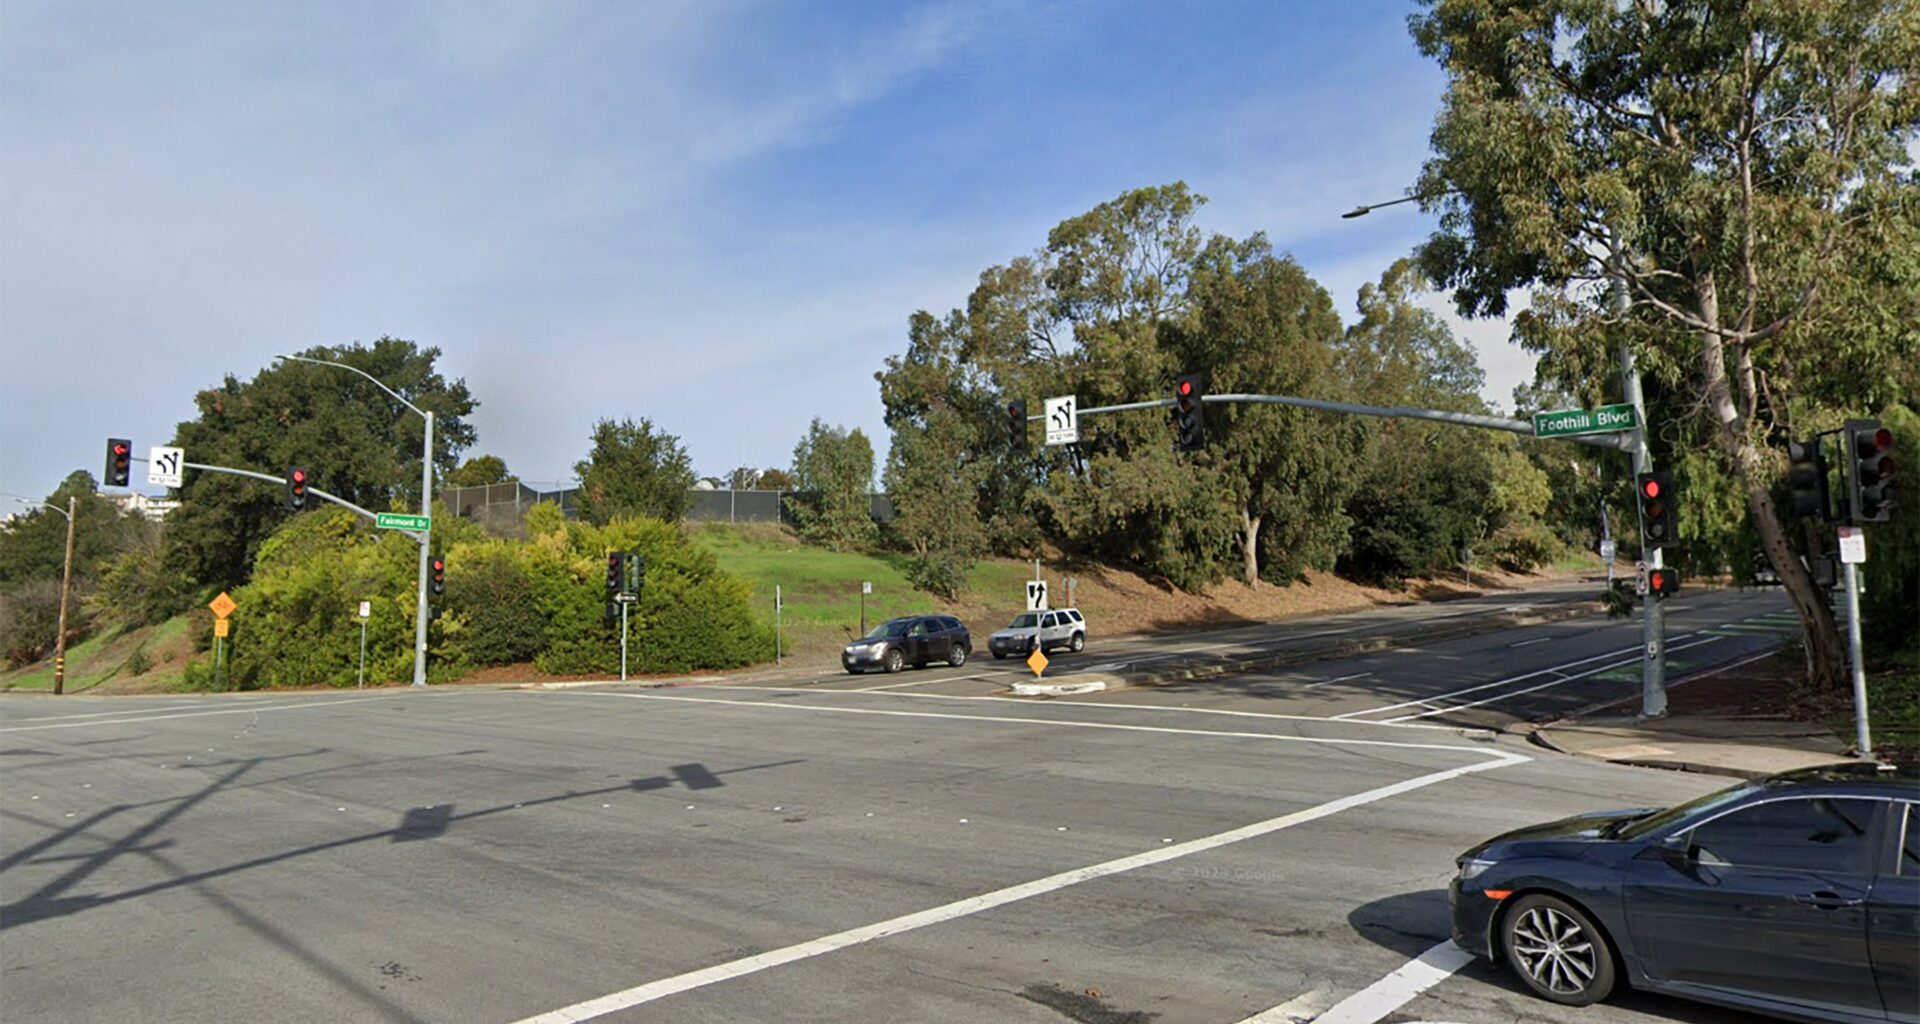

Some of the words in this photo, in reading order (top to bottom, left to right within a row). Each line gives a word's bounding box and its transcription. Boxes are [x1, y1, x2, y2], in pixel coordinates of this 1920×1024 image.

[1539, 415, 1590, 432] Foothill
[1597, 409, 1631, 426] Blvd
[379, 516, 415, 527] Fairmont
[417, 519, 427, 528] Dr
